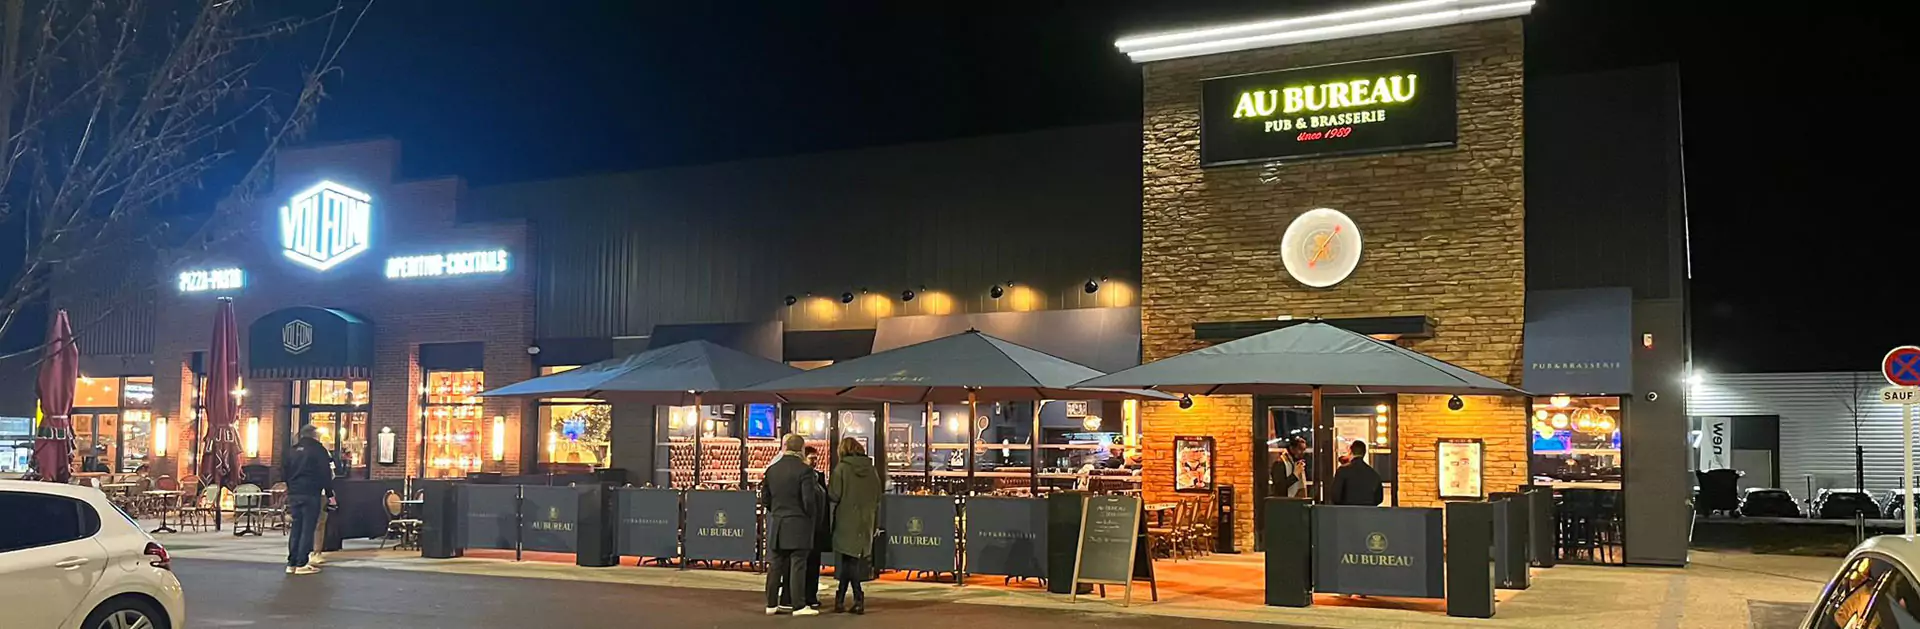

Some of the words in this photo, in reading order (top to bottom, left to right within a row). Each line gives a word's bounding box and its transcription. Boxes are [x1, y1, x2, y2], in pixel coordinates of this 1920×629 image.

[1233, 89, 1279, 118] AU
[1283, 73, 1418, 114] BUREAU
[1264, 118, 1292, 132] PUB
[1295, 117, 1308, 129] &
[1310, 109, 1386, 128] BRASSERIE
[1324, 126, 1352, 138] 1989
[280, 186, 371, 264] VOLFONI
[282, 321, 313, 350] VOLFONI
[1884, 391, 1913, 400] SAUF
[1712, 422, 1724, 455] new
[532, 521, 542, 530] AU
[543, 522, 574, 532] BUREAU
[697, 528, 709, 537] AU
[710, 528, 745, 538] BUREAU
[888, 535, 901, 545] AU
[903, 535, 942, 547] BUREAU
[1340, 553, 1359, 565] AU
[1360, 554, 1415, 567] BUREAU
